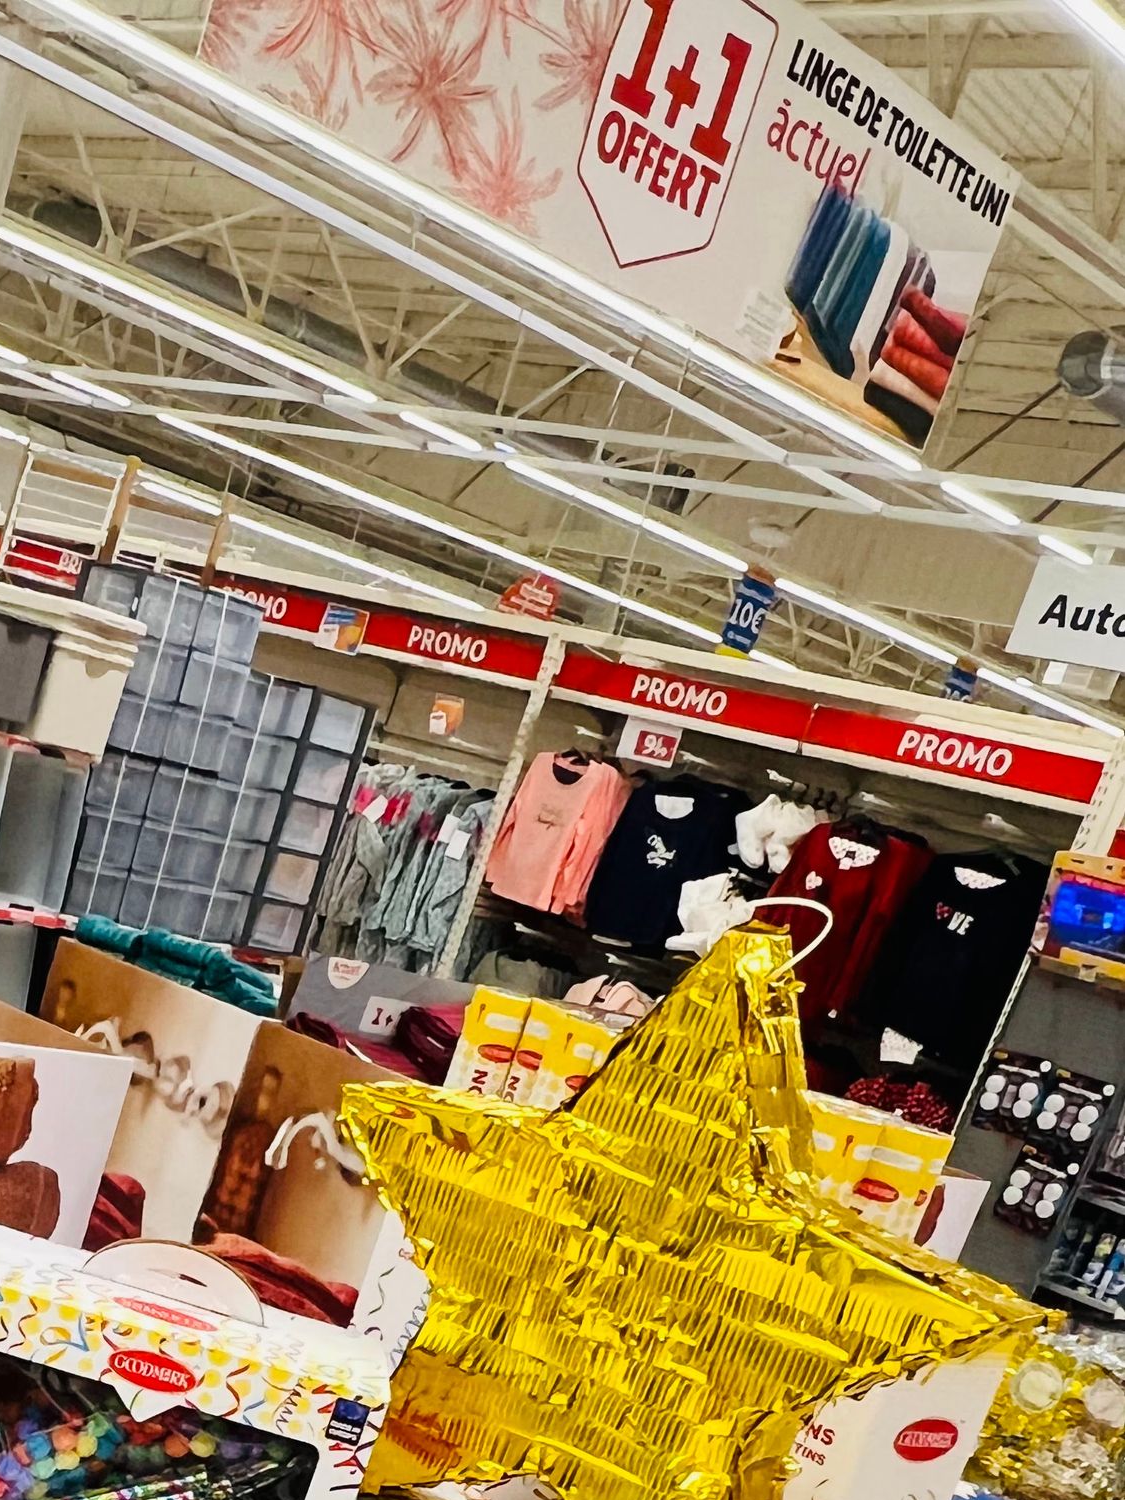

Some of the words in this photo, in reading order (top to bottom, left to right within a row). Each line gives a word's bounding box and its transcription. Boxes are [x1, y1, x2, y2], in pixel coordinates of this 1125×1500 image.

[610, 0, 752, 166] 1+1
[786, 39, 861, 117] LINGE
[854, 86, 889, 138] DE
[884, 106, 976, 202] TOILETTE
[970, 174, 1010, 227] UNI
[596, 110, 721, 218] OFFERT
[729, 599, 764, 634] 10€
[1038, 594, 1125, 637] Auto
[407, 625, 487, 664] PROMO
[631, 673, 728, 717] PROMO
[896, 730, 1013, 777] PROMO
